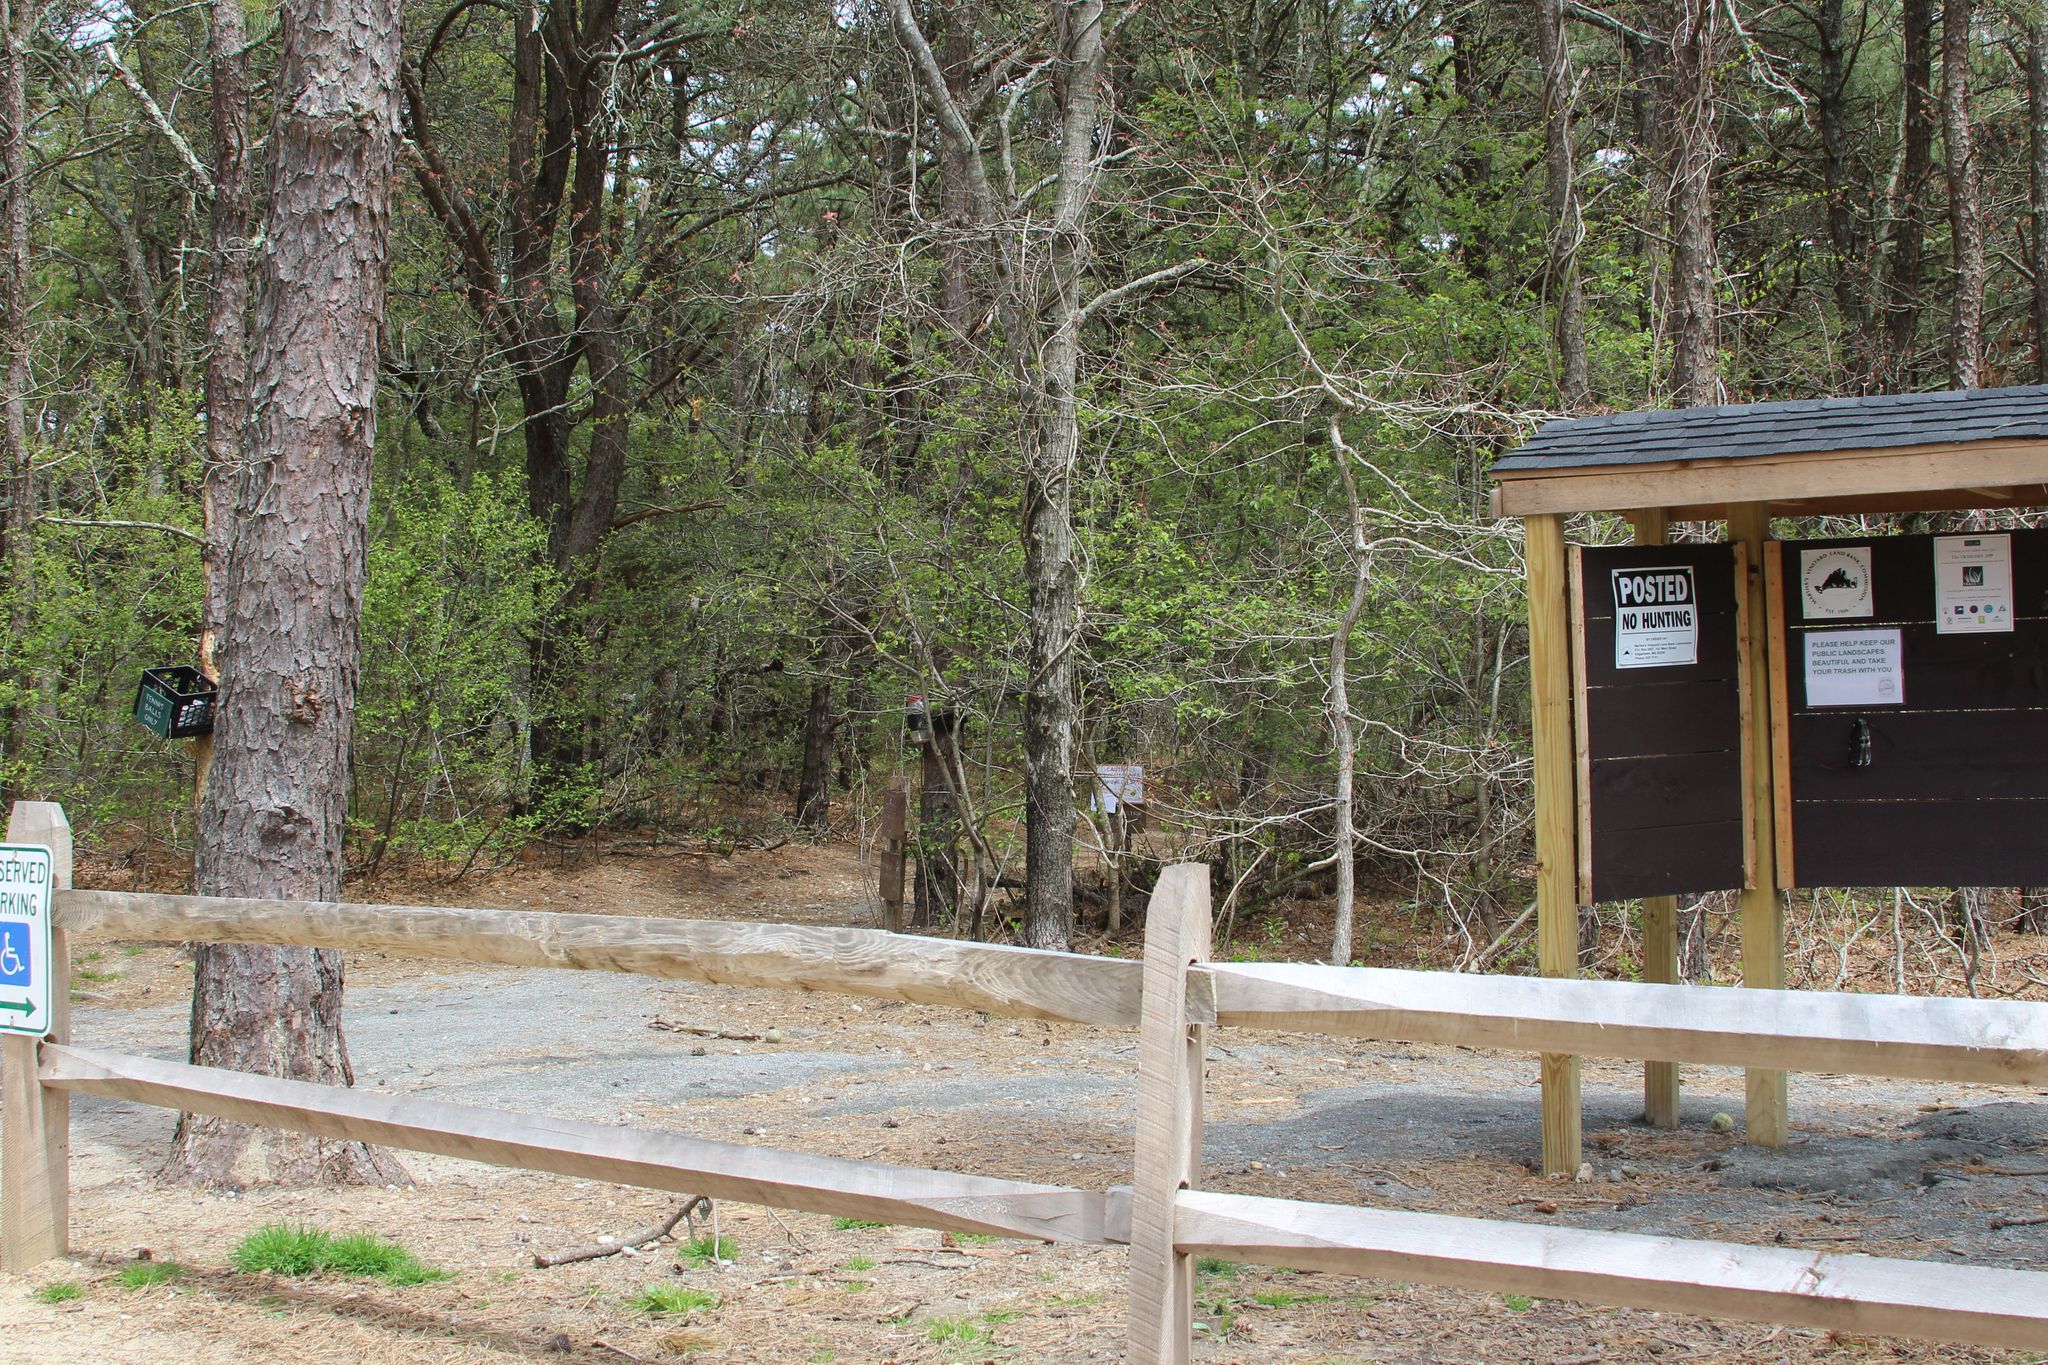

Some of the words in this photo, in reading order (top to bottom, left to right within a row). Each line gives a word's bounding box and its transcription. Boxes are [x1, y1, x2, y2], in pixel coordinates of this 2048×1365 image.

[1807, 553, 1827, 575] VINEYARD
[1846, 553, 1860, 563] BANK
[1619, 575, 1688, 604] POSTED
[1623, 613, 1637, 629] NO
[1642, 610, 1692, 629] HUNTING
[1838, 648, 1885, 656] LANDSCAPES
[146, 693, 165, 710] TENNIS
[145, 703, 162, 719] BALLS
[144, 714, 158, 726] ONLY
